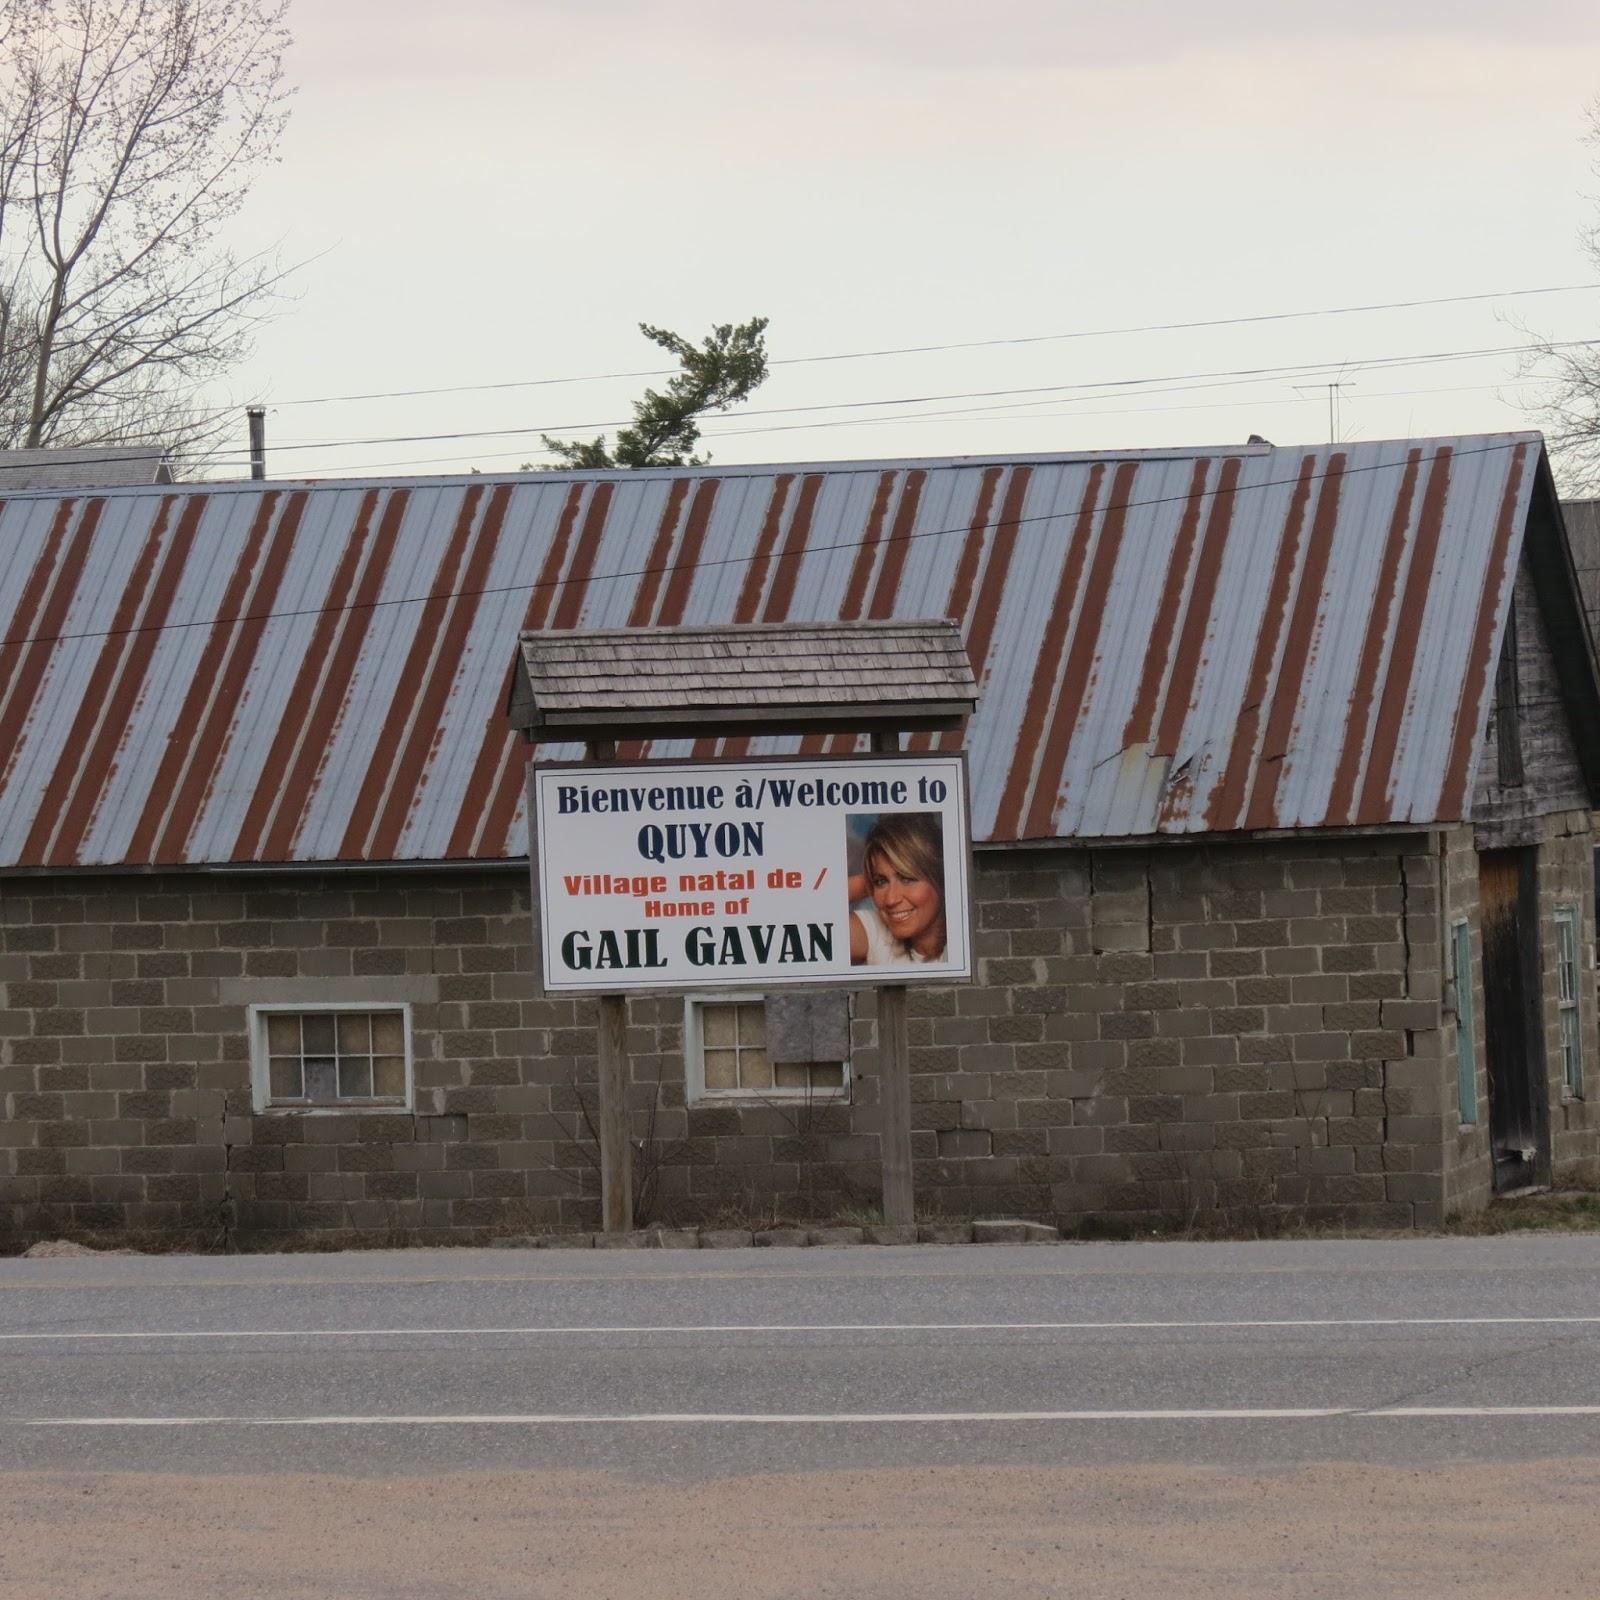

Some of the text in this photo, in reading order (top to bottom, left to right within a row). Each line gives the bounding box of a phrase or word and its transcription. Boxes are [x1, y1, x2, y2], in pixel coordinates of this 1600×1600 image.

[557, 776, 947, 814] Bienvenue à/Welcome to
[637, 821, 765, 863] QUYON
[563, 874, 668, 897] Village
[679, 870, 755, 892] natal
[767, 868, 803, 889] de
[645, 898, 750, 918] Home of
[561, 923, 834, 970] GAIL GAVAN
